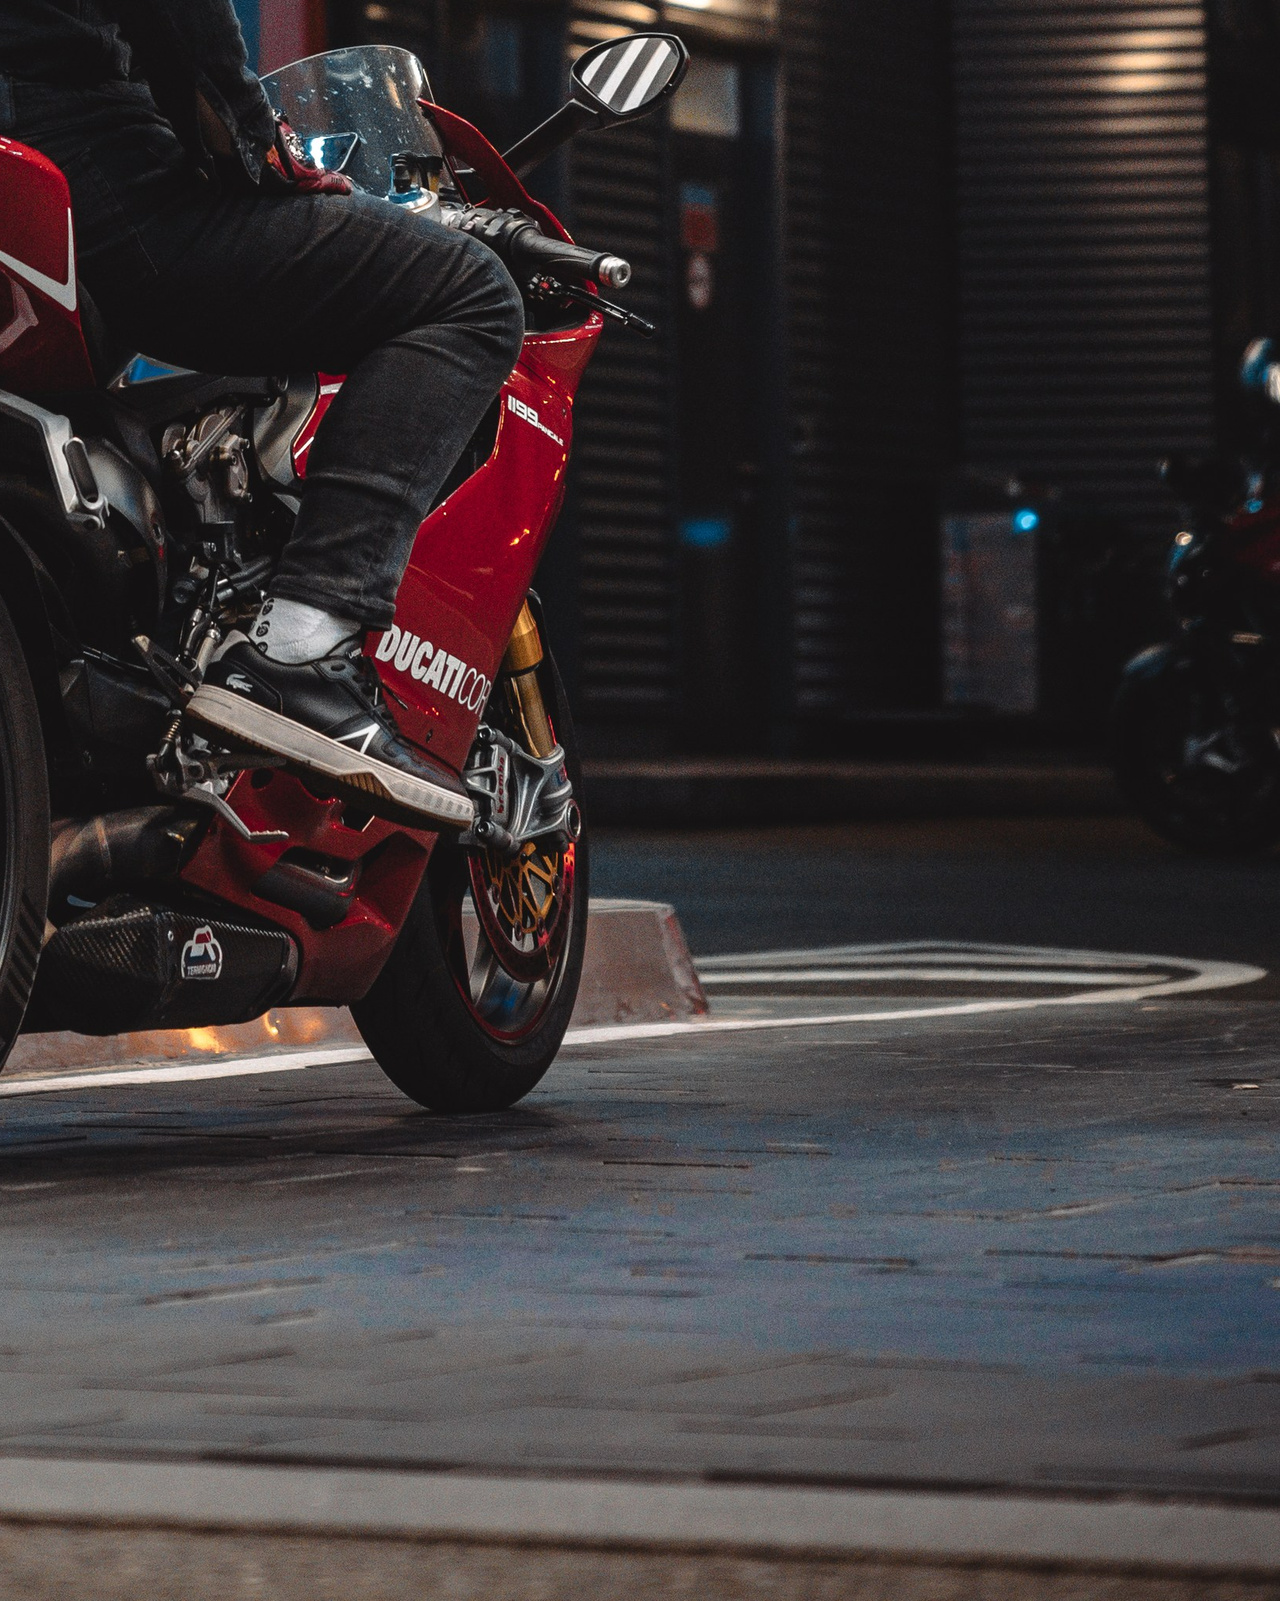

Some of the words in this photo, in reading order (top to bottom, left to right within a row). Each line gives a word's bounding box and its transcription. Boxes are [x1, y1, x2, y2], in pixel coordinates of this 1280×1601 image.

[507, 394, 539, 427] 1199
[375, 623, 467, 699] DUCATI
[458, 667, 492, 721] COR
